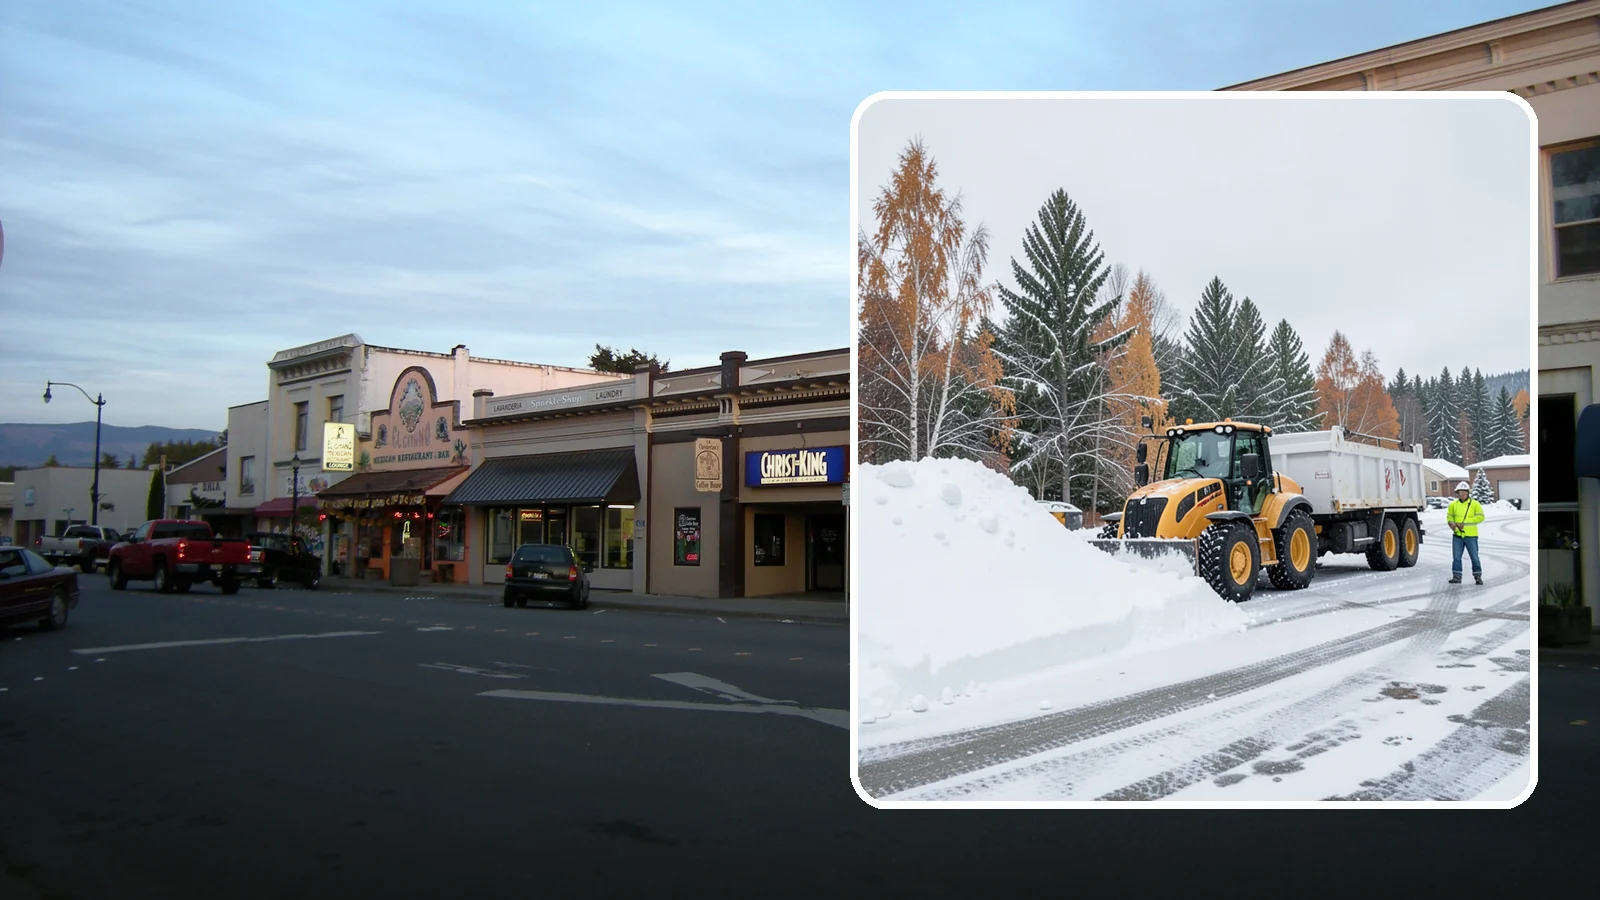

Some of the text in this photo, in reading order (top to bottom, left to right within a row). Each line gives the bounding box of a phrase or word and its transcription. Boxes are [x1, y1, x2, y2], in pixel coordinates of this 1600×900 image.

[595, 389, 623, 400] LAUNDRY
[493, 402, 523, 412] LAVANDERIA
[530, 394, 582, 409] Sparkle Shop
[373, 454, 396, 464] MEXICAN
[397, 451, 433, 462] RESTAURANT
[437, 450, 450, 459] BAR
[760, 449, 827, 478] CHRIST KING
[696, 480, 722, 488] Coffee House
